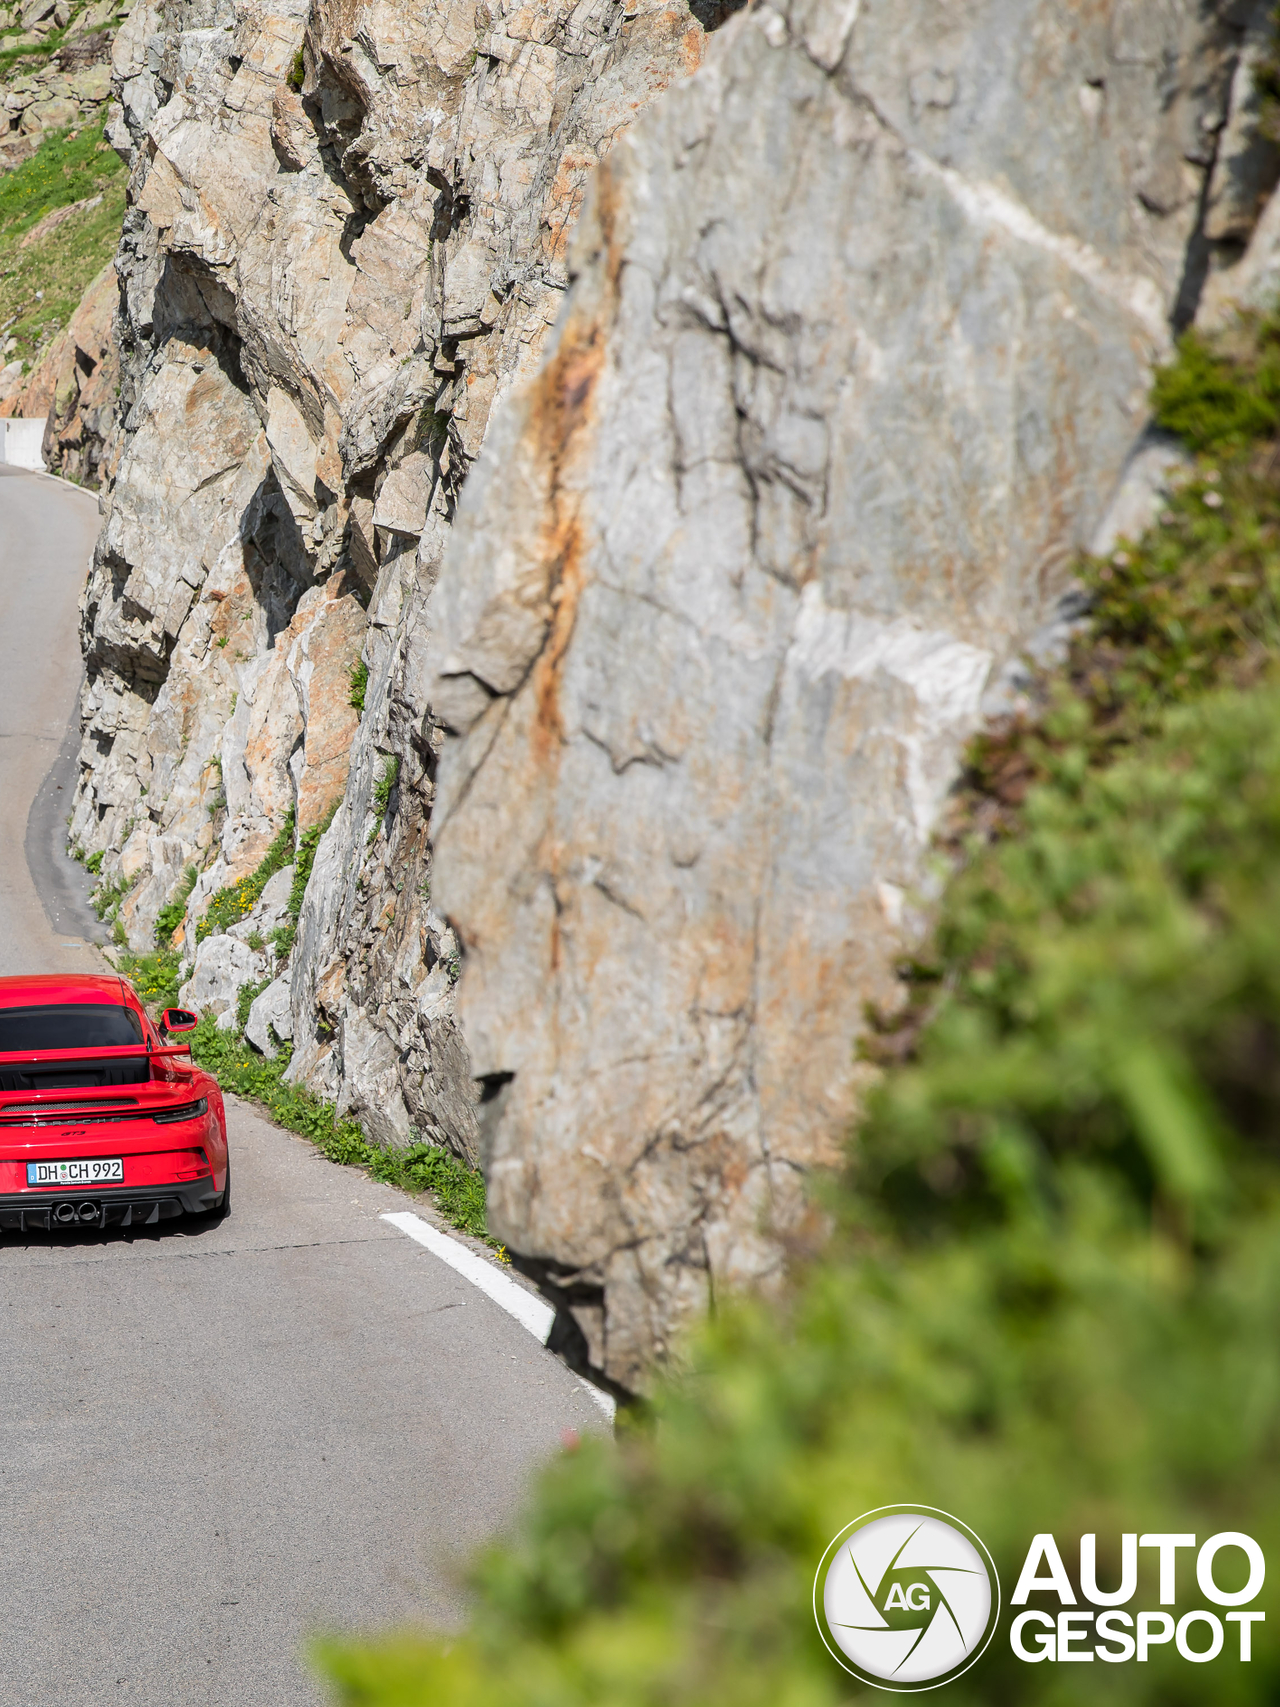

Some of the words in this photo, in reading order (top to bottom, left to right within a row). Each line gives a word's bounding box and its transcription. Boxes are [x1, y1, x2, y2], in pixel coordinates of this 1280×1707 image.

[38, 1165, 58, 1181] DH
[68, 1163, 89, 1179] CH
[92, 1162, 122, 1178] 992
